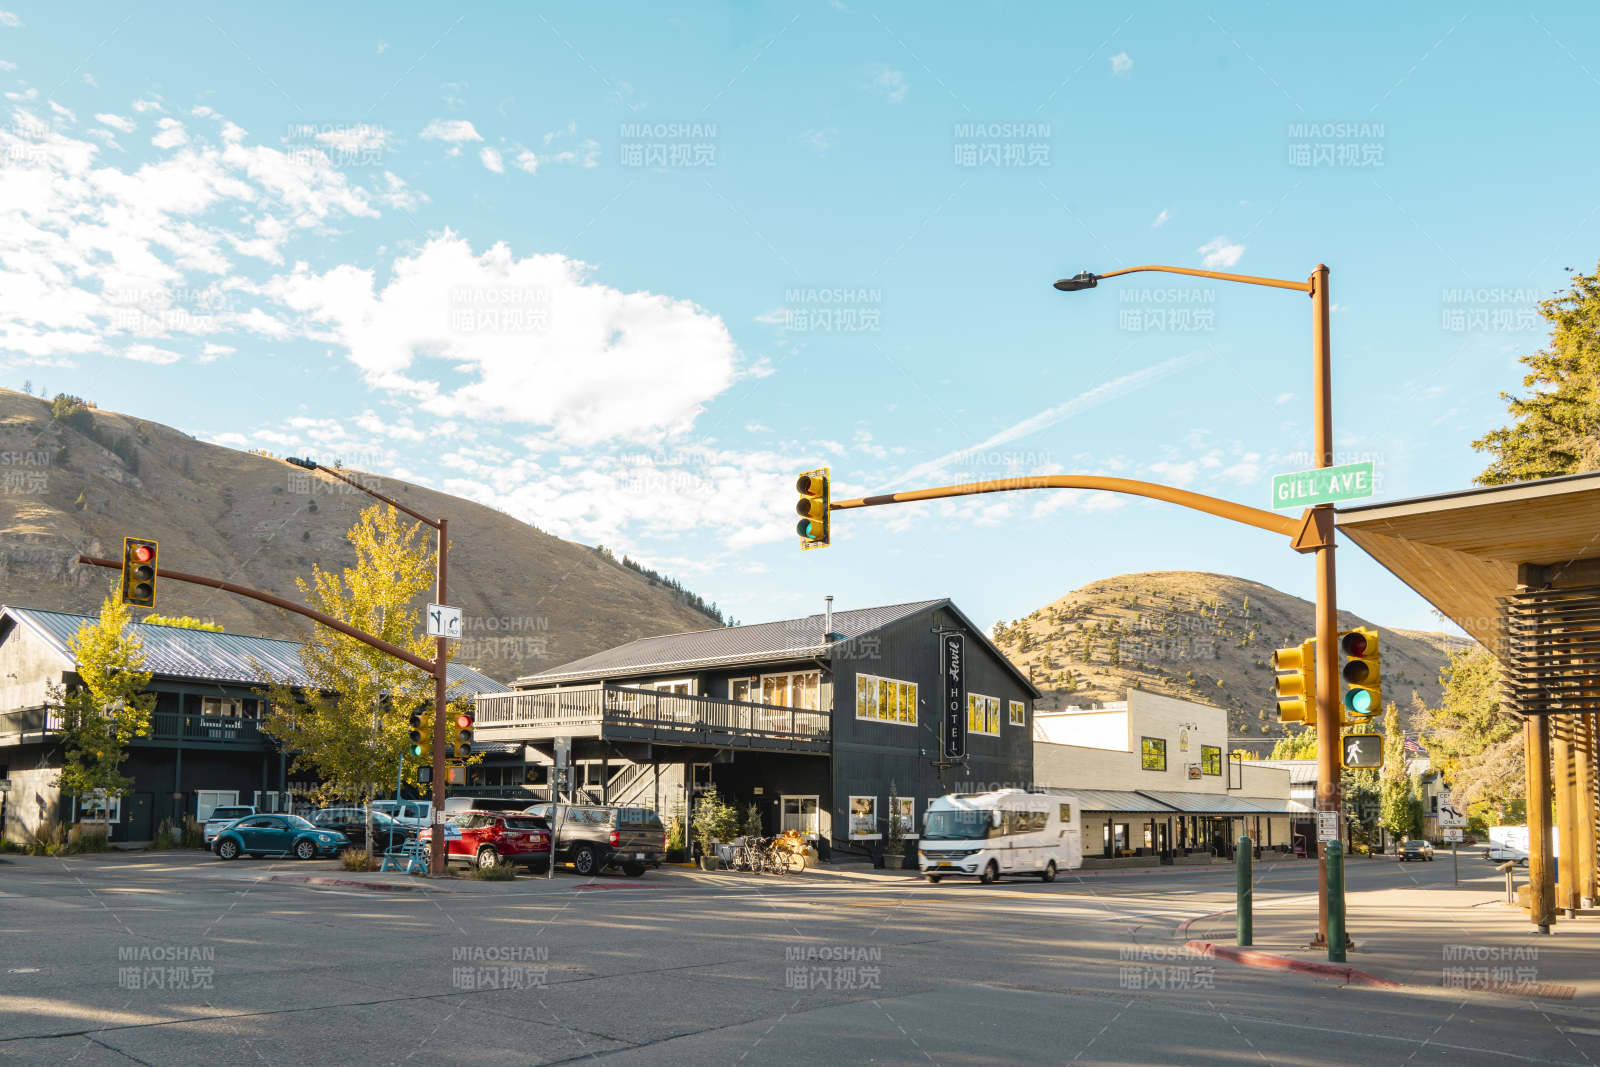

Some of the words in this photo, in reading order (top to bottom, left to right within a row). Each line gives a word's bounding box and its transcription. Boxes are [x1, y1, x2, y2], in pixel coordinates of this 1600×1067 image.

[1278, 479, 1319, 501] GILL
[1328, 471, 1367, 494] AVE
[950, 688, 959, 751] HOTEL
